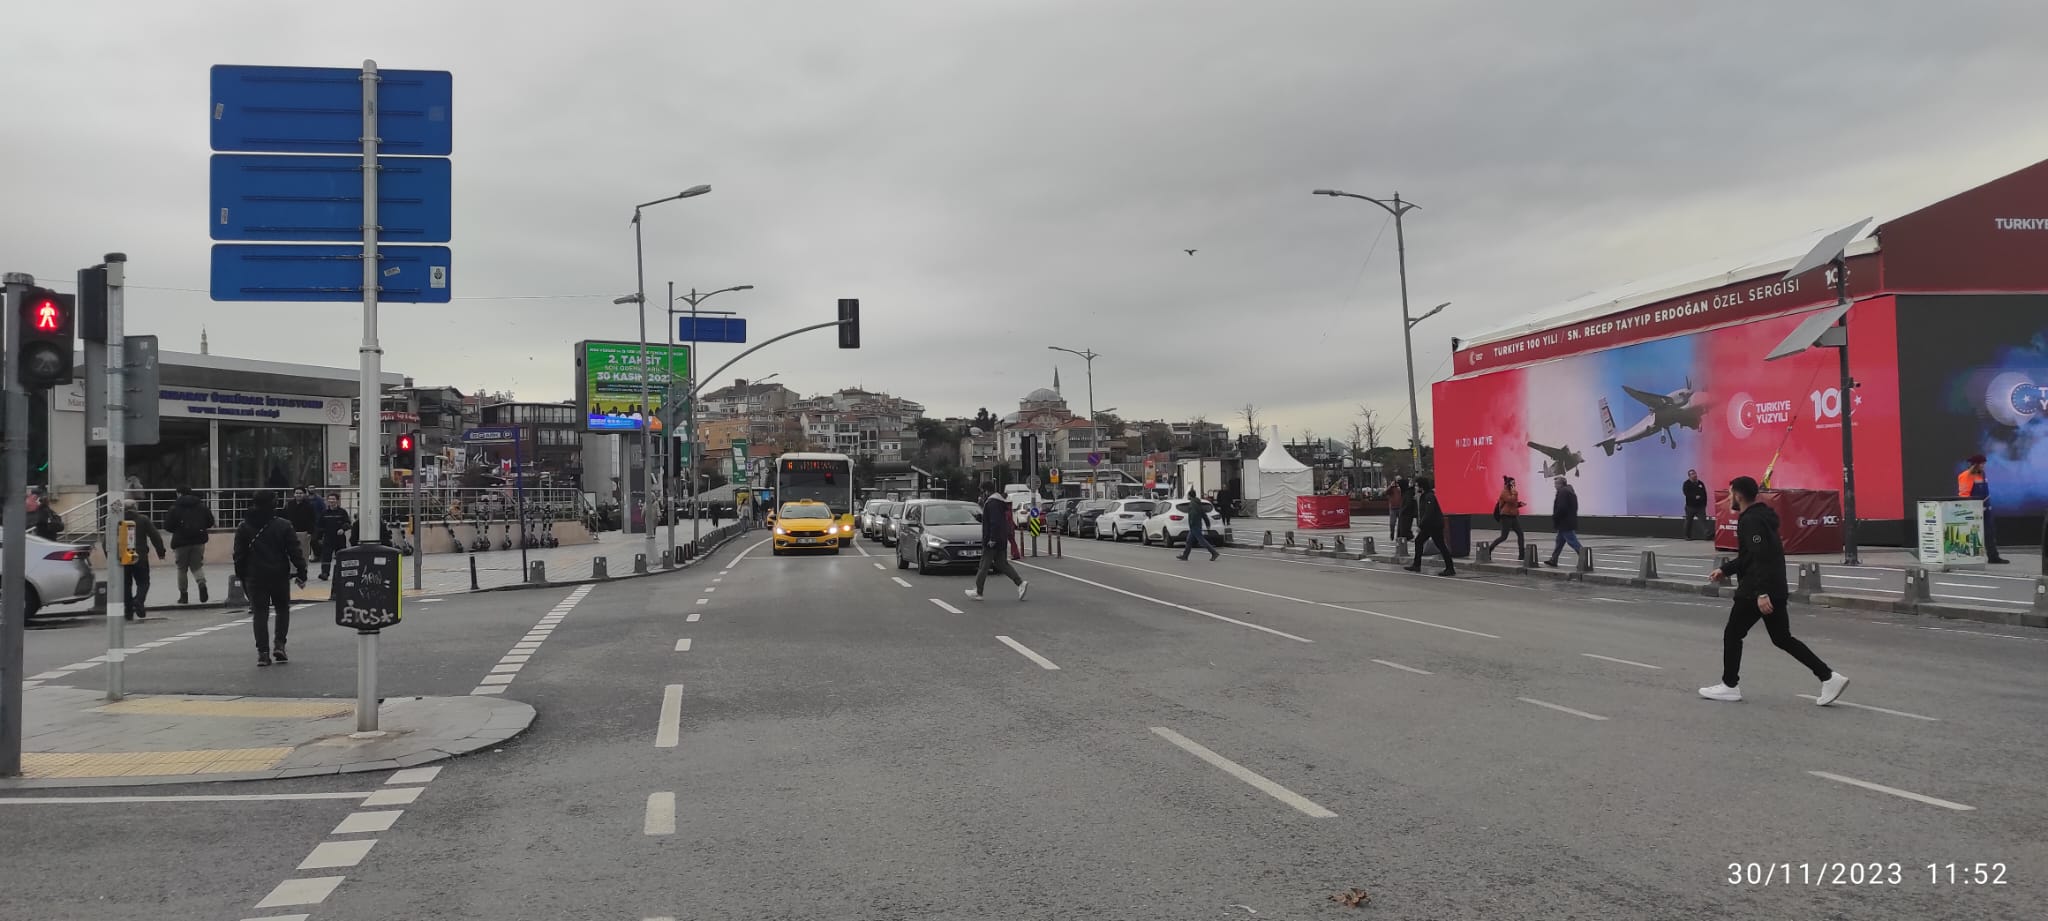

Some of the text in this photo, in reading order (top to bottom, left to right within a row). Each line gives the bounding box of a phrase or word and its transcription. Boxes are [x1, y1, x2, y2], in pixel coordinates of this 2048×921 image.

[1527, 338, 1541, 350] 100
[1543, 333, 1558, 346] YILI
[1567, 329, 1582, 341] SN.
[1584, 322, 1613, 337] RECEP
[1654, 300, 1709, 323] ERDOĞAN
[1713, 292, 1744, 310] ÖZEL
